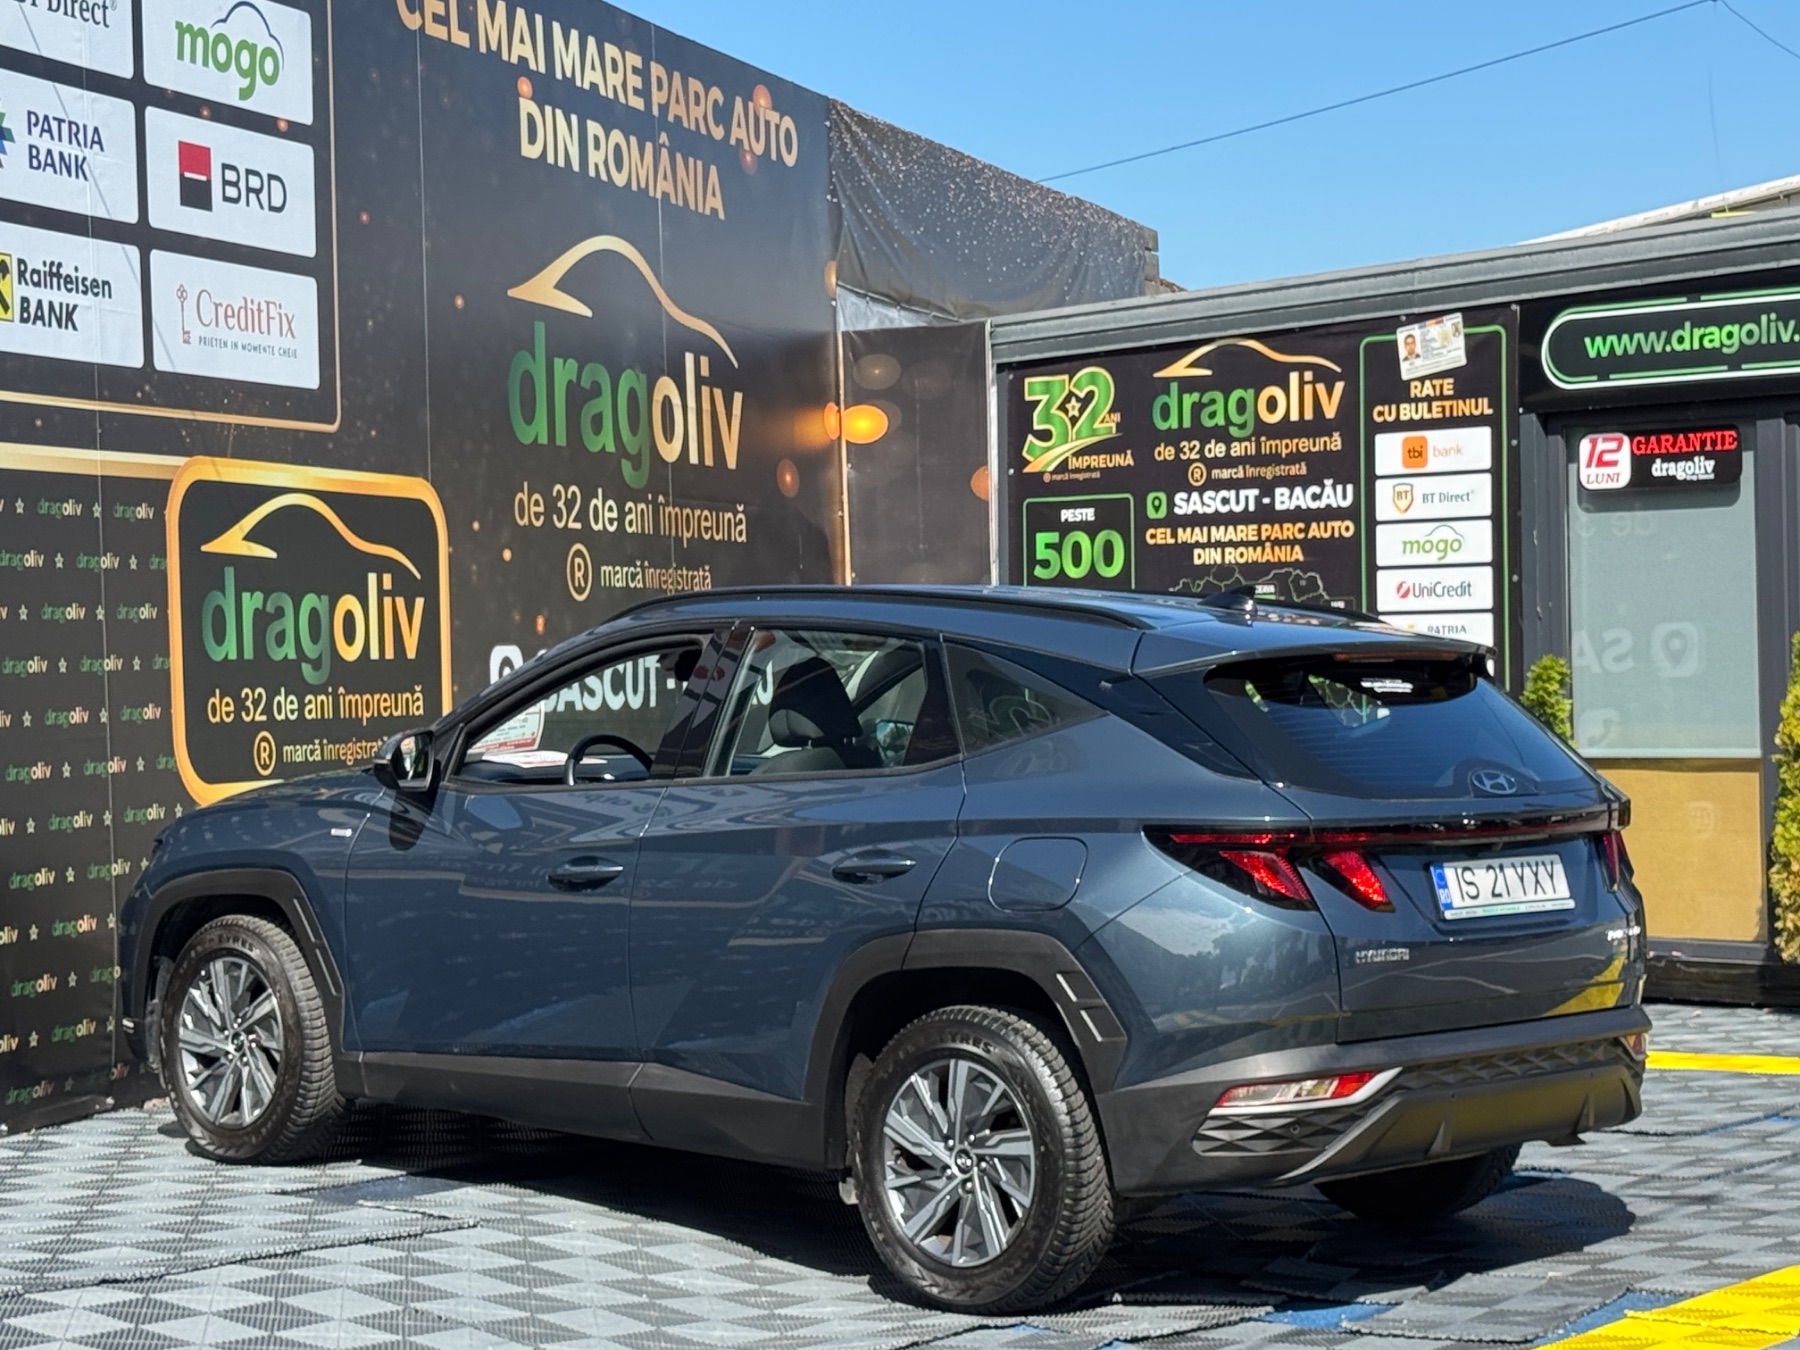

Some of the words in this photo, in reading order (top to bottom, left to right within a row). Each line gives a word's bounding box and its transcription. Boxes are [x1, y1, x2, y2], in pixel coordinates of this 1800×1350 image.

[175, 20, 281, 101] mogo
[477, 0, 546, 74] MAI
[552, 21, 645, 112] MARE
[650, 61, 725, 141] PARC
[729, 97, 798, 168] AUTO
[26, 110, 105, 152] PATRIA
[27, 143, 89, 182] BANK
[518, 97, 580, 173] DIN
[586, 120, 725, 220] ROMÂNIA
[221, 163, 288, 214] BRD
[17, 258, 113, 300] Raiffeisen
[19, 296, 79, 332] BANK
[196, 288, 297, 340] CreditFix
[198, 335, 229, 350] PRIETEN
[230, 340, 239, 350] IN
[241, 341, 276, 356] MOMENTE
[278, 346, 298, 359] CHEIE
[1410, 377, 1455, 399] RATE
[507, 321, 743, 489] dragoliv
[1022, 366, 1115, 463] 32
[1153, 371, 1345, 438] dragoliv
[1372, 404, 1397, 423] CU
[1399, 397, 1494, 421] BULETINUL
[1154, 442, 1175, 461] de
[1179, 440, 1201, 460] 32
[1204, 439, 1226, 459] de
[1230, 437, 1256, 458] ani
[1259, 431, 1342, 459] împreună
[1407, 445, 1424, 460] tbi
[1432, 444, 1463, 458] bank
[1585, 436, 1625, 469] 12
[1632, 430, 1738, 455] GARANTIE
[1068, 449, 1135, 471] ÎMPREUNĂ
[1211, 464, 1245, 480] marcă
[1246, 461, 1307, 481] înregistrată
[1651, 455, 1716, 480] dragoliv
[1586, 472, 1621, 485] LUNI
[37, 498, 82, 519] dragoliv
[113, 502, 155, 522] dragoliv
[1173, 488, 1260, 515] SASCUT
[1274, 478, 1354, 511] BACĂU
[1396, 490, 1410, 501] BT
[1422, 493, 1436, 504] BT
[1439, 491, 1471, 503] Direct
[514, 481, 545, 527] de
[552, 483, 583, 530] 32
[589, 487, 619, 533] de
[624, 493, 654, 536] ani
[658, 494, 747, 549] împreună
[1060, 507, 1096, 522] PESTE
[1145, 527, 1175, 545] CEL
[1177, 526, 1208, 544] MAI
[1210, 523, 1259, 543] MARE
[1261, 521, 1305, 541] PARC
[1307, 519, 1355, 539] AUTO
[0, 550, 45, 571] dragoliv
[76, 552, 120, 573] dragoliv
[1033, 529, 1125, 580] 500
[1193, 547, 1222, 566] DIN
[1224, 541, 1304, 565] ROMÂNIA
[1402, 538, 1463, 561] mogo
[600, 560, 644, 589] marcă
[645, 560, 712, 595] înregistrată
[1412, 580, 1472, 598] UniCredit
[41, 603, 86, 624] dragoliv
[116, 603, 158, 623] dragoliv
[202, 565, 425, 685] dragoliv
[2, 656, 48, 678] dragoliv
[80, 654, 123, 676] dragoliv
[44, 706, 89, 728] dragoliv
[120, 703, 161, 724] dragoliv
[208, 688, 234, 724] de
[241, 687, 267, 722] 32
[273, 686, 298, 721] de
[304, 688, 333, 720] ani
[337, 684, 424, 726] împreună
[283, 738, 321, 763] marcă
[323, 736, 388, 765] înregistrat
[5, 761, 52, 785] dragoliv
[83, 756, 127, 778] dragoliv
[48, 810, 93, 833] dragoliv
[123, 803, 166, 825] dragoliv
[9, 868, 55, 891] dragoliv
[87, 858, 131, 881] dragoliv
[1455, 866, 1480, 902] IS
[1486, 863, 1510, 898] 21
[1511, 861, 1557, 897] YXY
[1439, 889, 1451, 904] RO
[51, 915, 97, 938] dragoliv
[11, 974, 57, 998] dragoliv
[89, 965, 121, 984] drago
[52, 1018, 97, 1042] dragoliv
[5, 1080, 54, 1105] dragoliv
